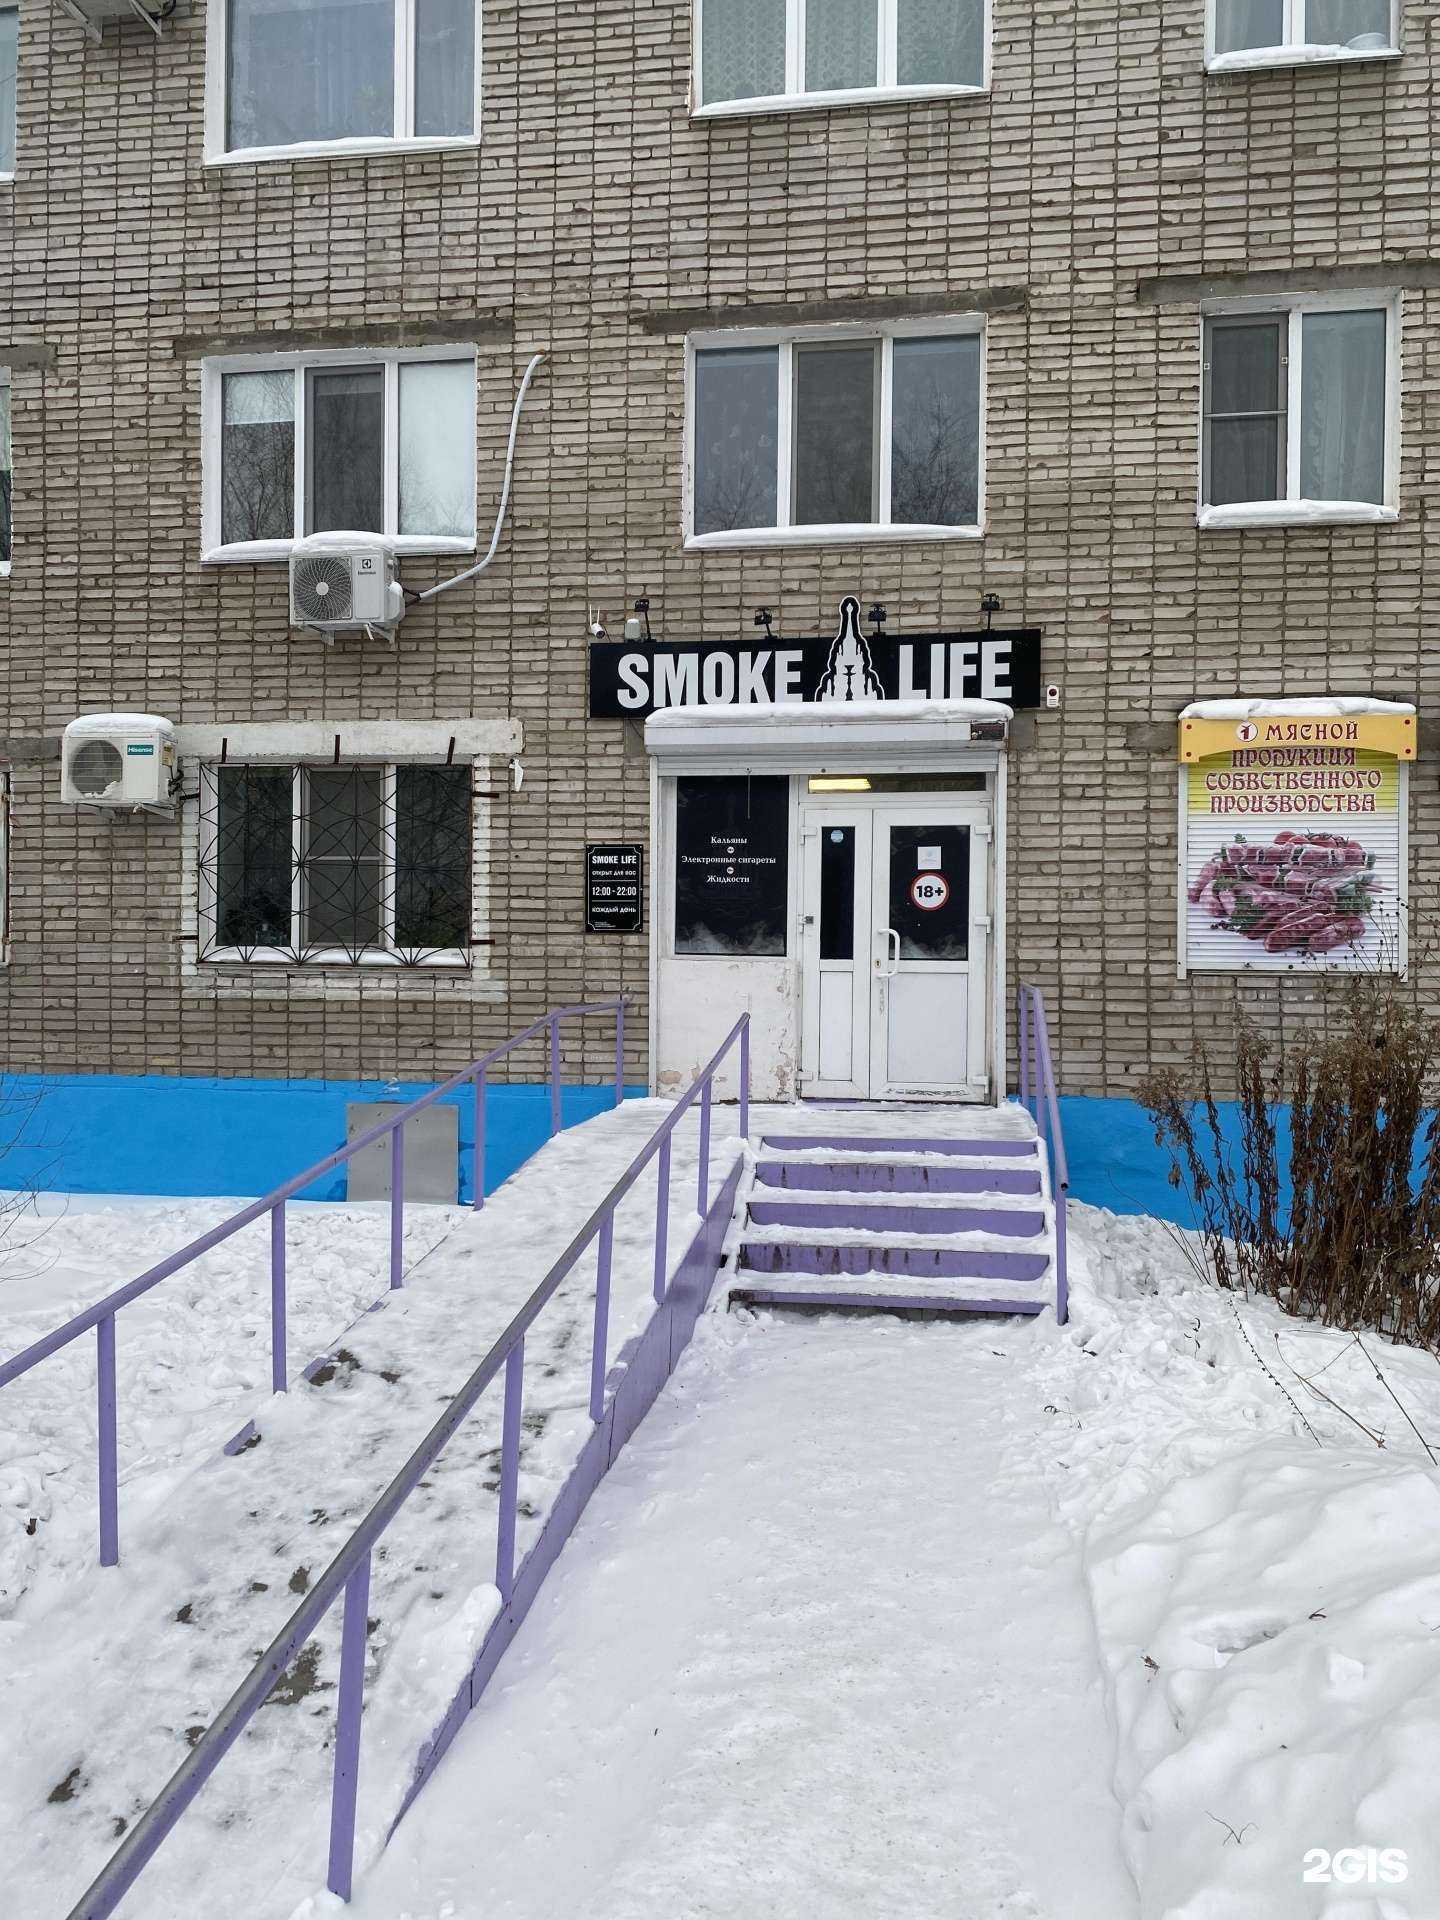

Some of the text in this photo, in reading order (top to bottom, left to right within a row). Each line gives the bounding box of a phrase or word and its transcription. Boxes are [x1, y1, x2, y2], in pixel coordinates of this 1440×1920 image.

[616, 640, 1013, 709] SMOKE LIFE
[1265, 720, 1359, 741] МЯСНОЙ
[1231, 747, 1356, 768] ПРОДУКЦИЯ
[1210, 793, 1376, 814] ПРОИЗВОДСТВА
[710, 836, 748, 844] Кальяны
[591, 855, 637, 864] SMOKE LIFE
[681, 855, 776, 866] Электронные сигареты
[706, 875, 750, 884] Жидкости
[591, 886, 611, 896] 12:00
[616, 886, 637, 896] 22:00
[915, 885, 944, 898] 18+
